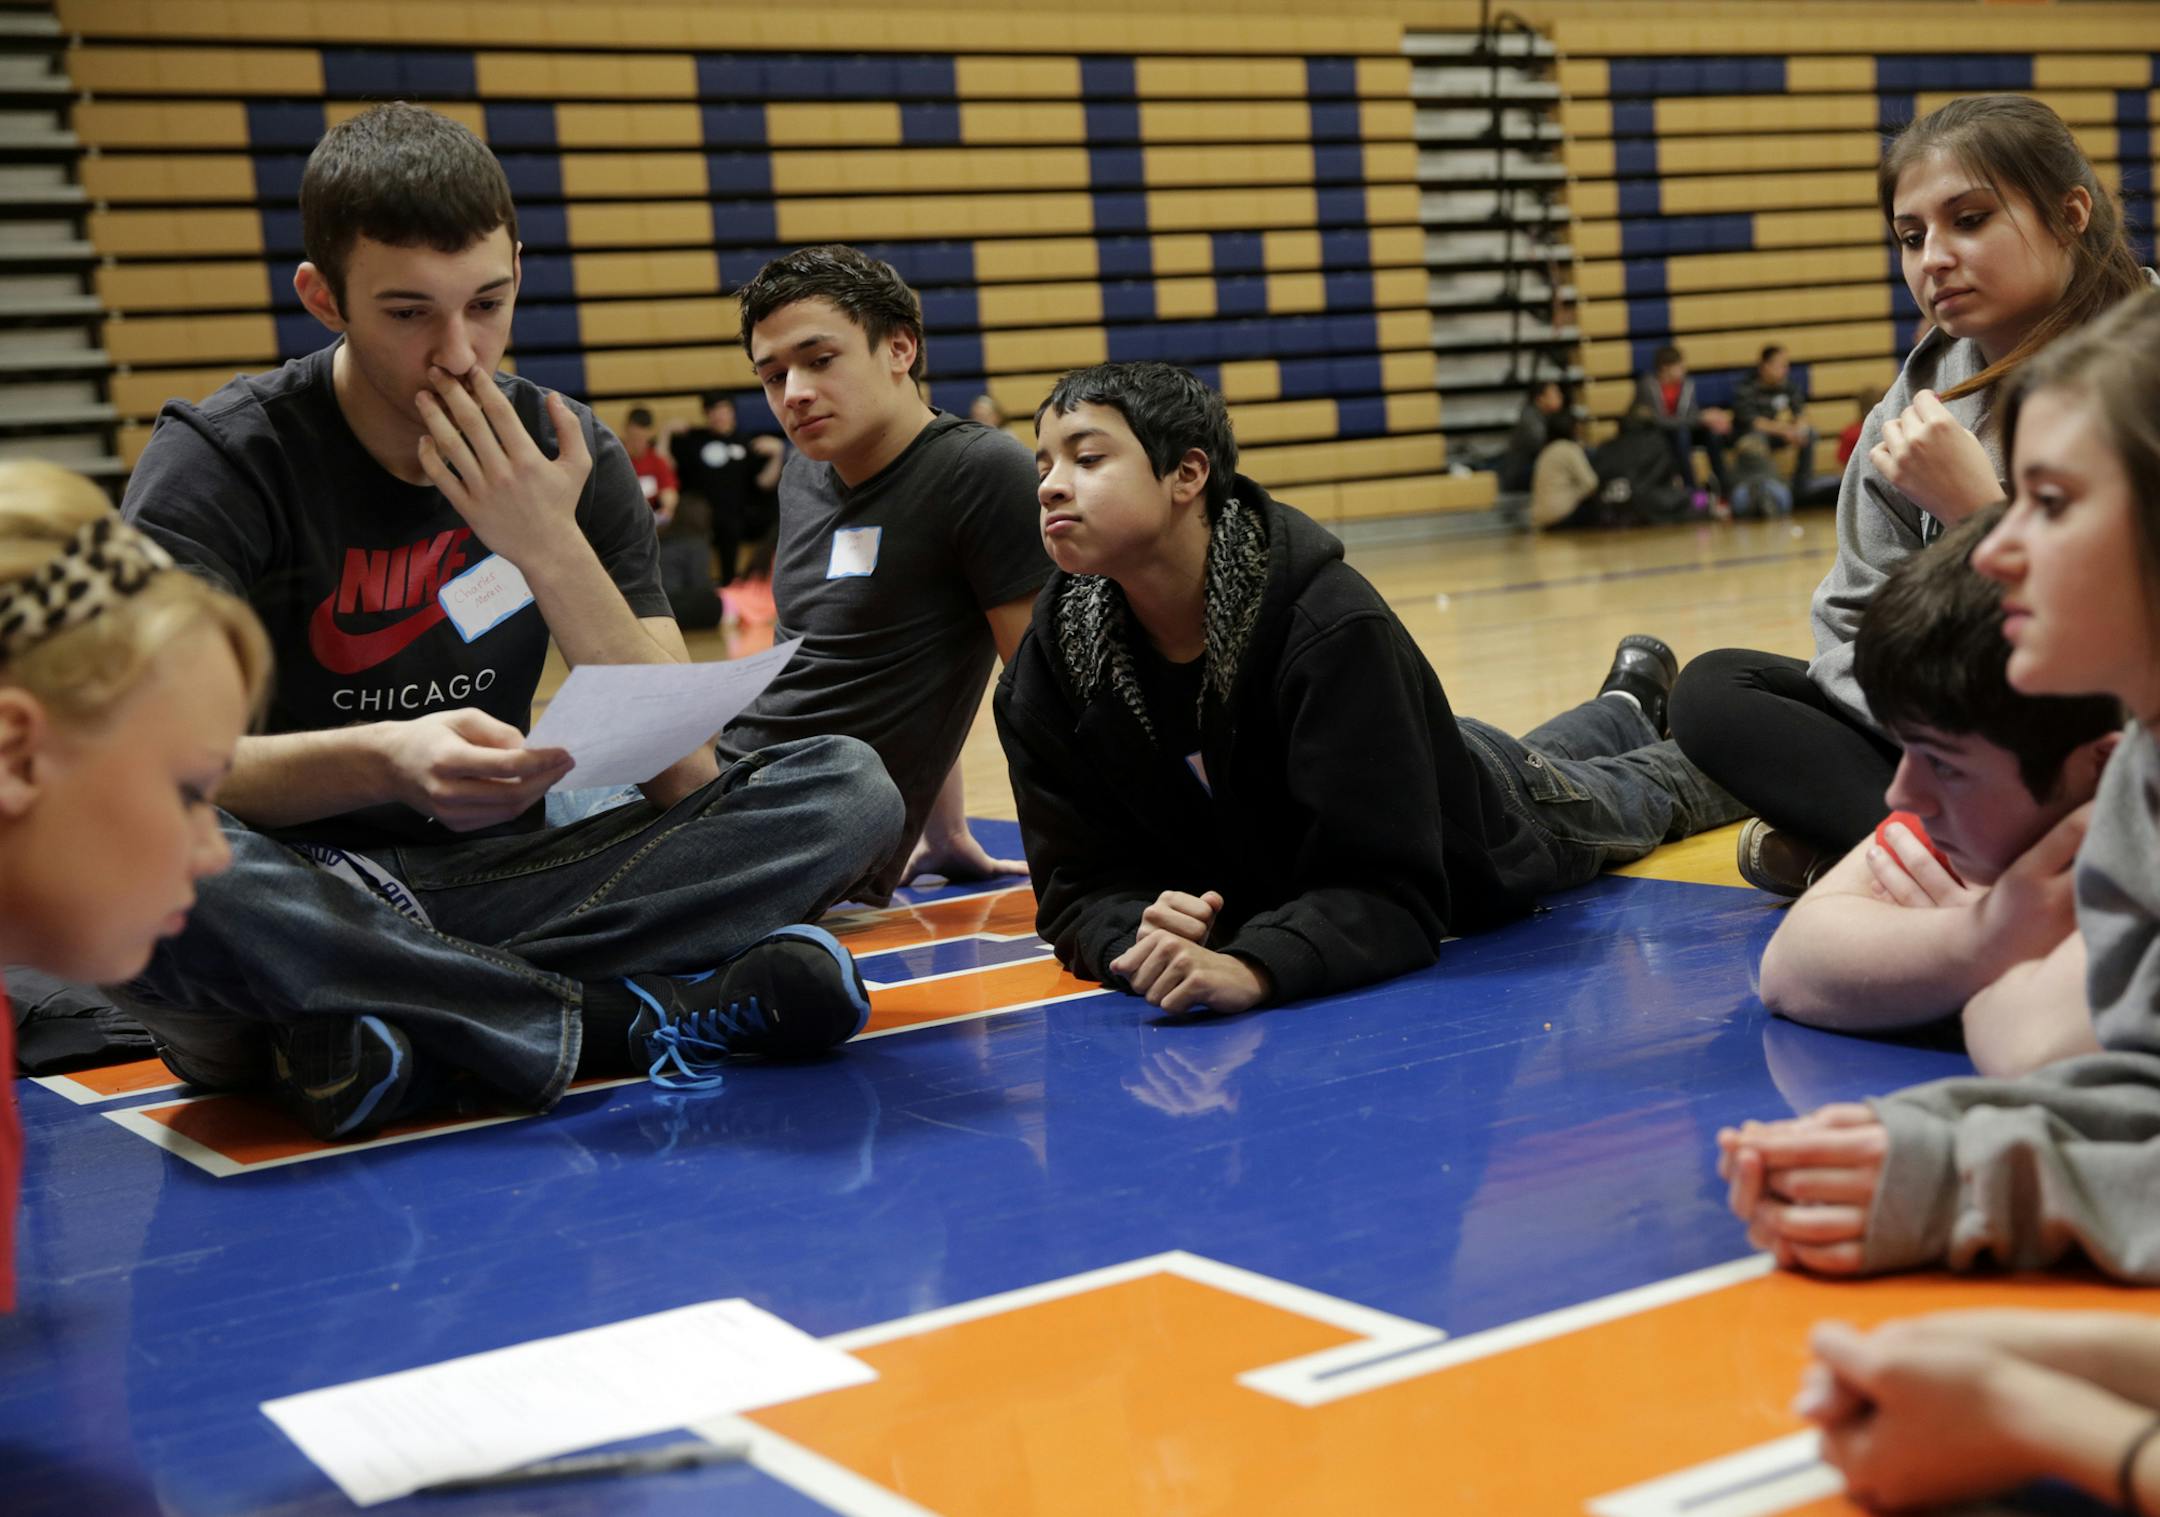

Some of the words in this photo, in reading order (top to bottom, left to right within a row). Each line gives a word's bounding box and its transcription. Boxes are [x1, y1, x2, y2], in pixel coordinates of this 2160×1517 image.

[338, 527, 473, 614] NIKE
[455, 572, 496, 604] Charles
[333, 668, 497, 711] CHICAGO
